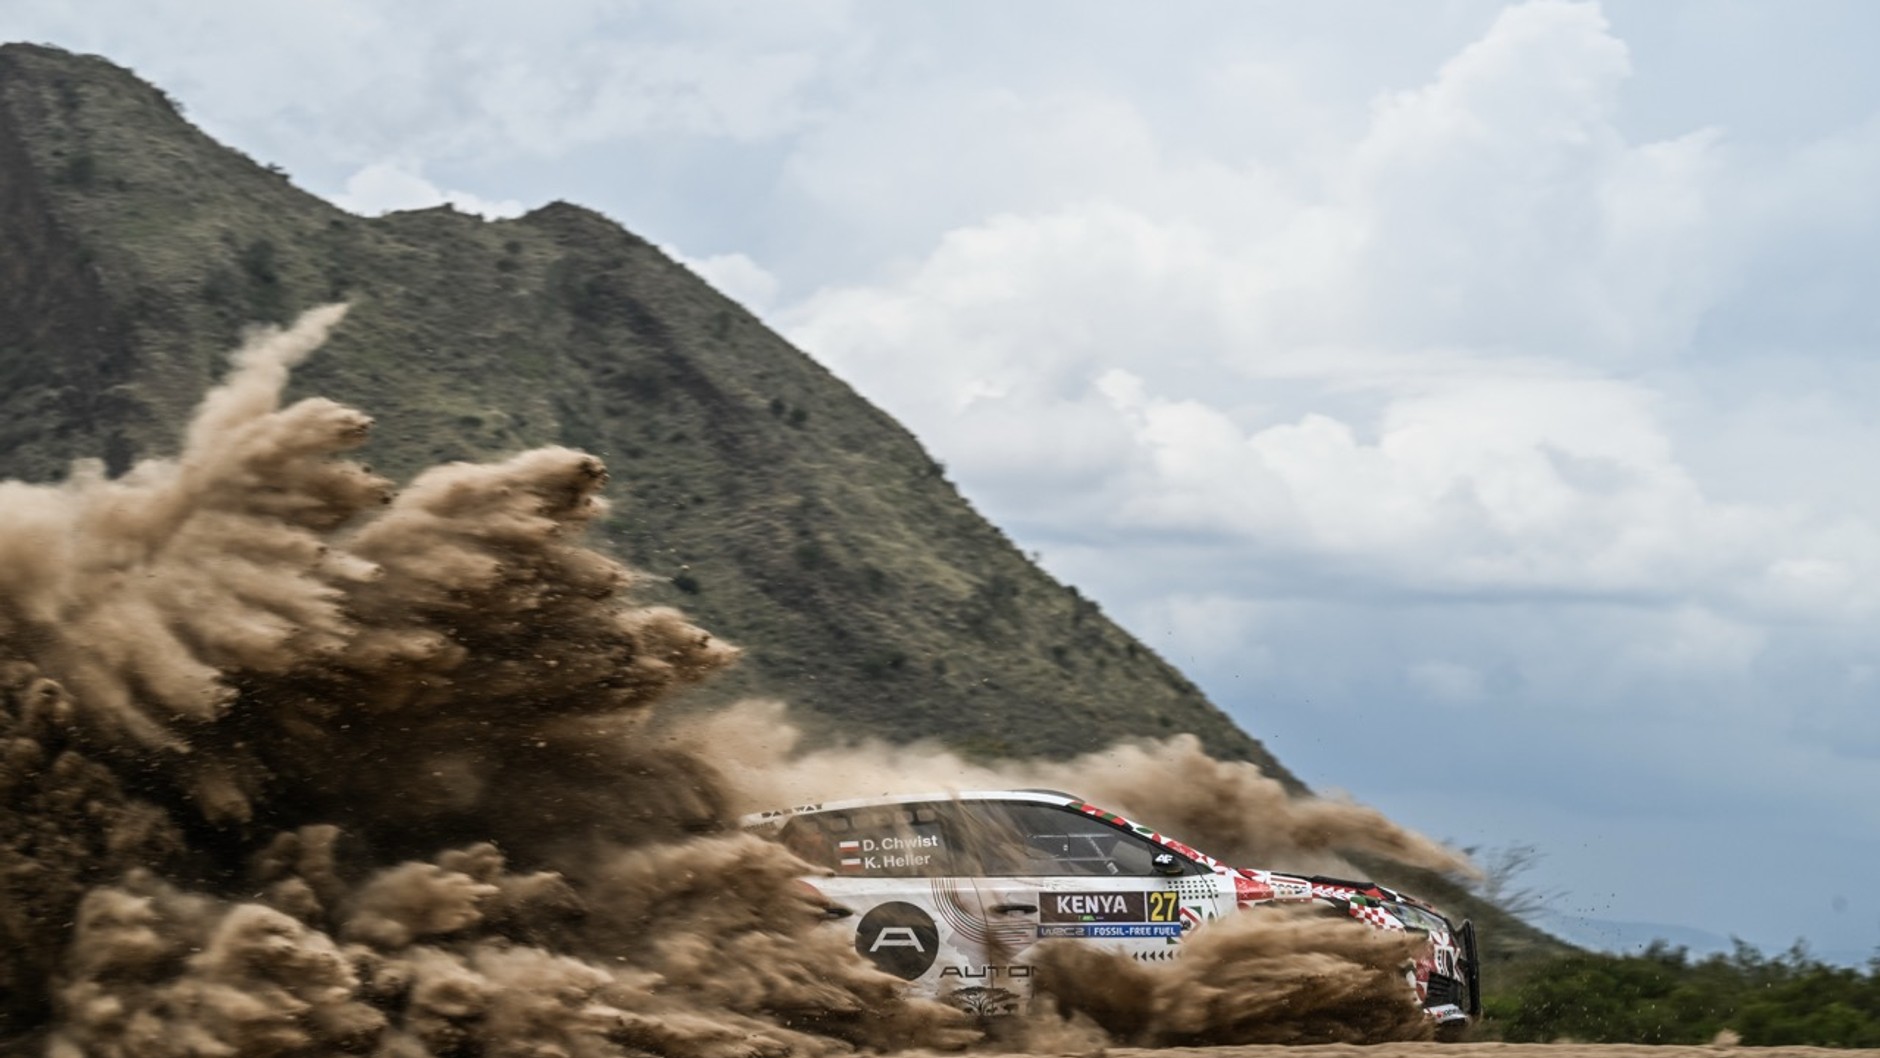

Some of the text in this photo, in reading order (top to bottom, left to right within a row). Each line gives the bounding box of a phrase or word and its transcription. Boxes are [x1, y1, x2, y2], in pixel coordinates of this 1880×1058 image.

[863, 835, 938, 852] D. Chwist
[864, 856, 881, 869] K.
[1057, 892, 1177, 922] KENYA 27
[1041, 926, 1176, 936] WRC2 FOSSIL-FREE FUEL
[939, 965, 1037, 978] AUTO
